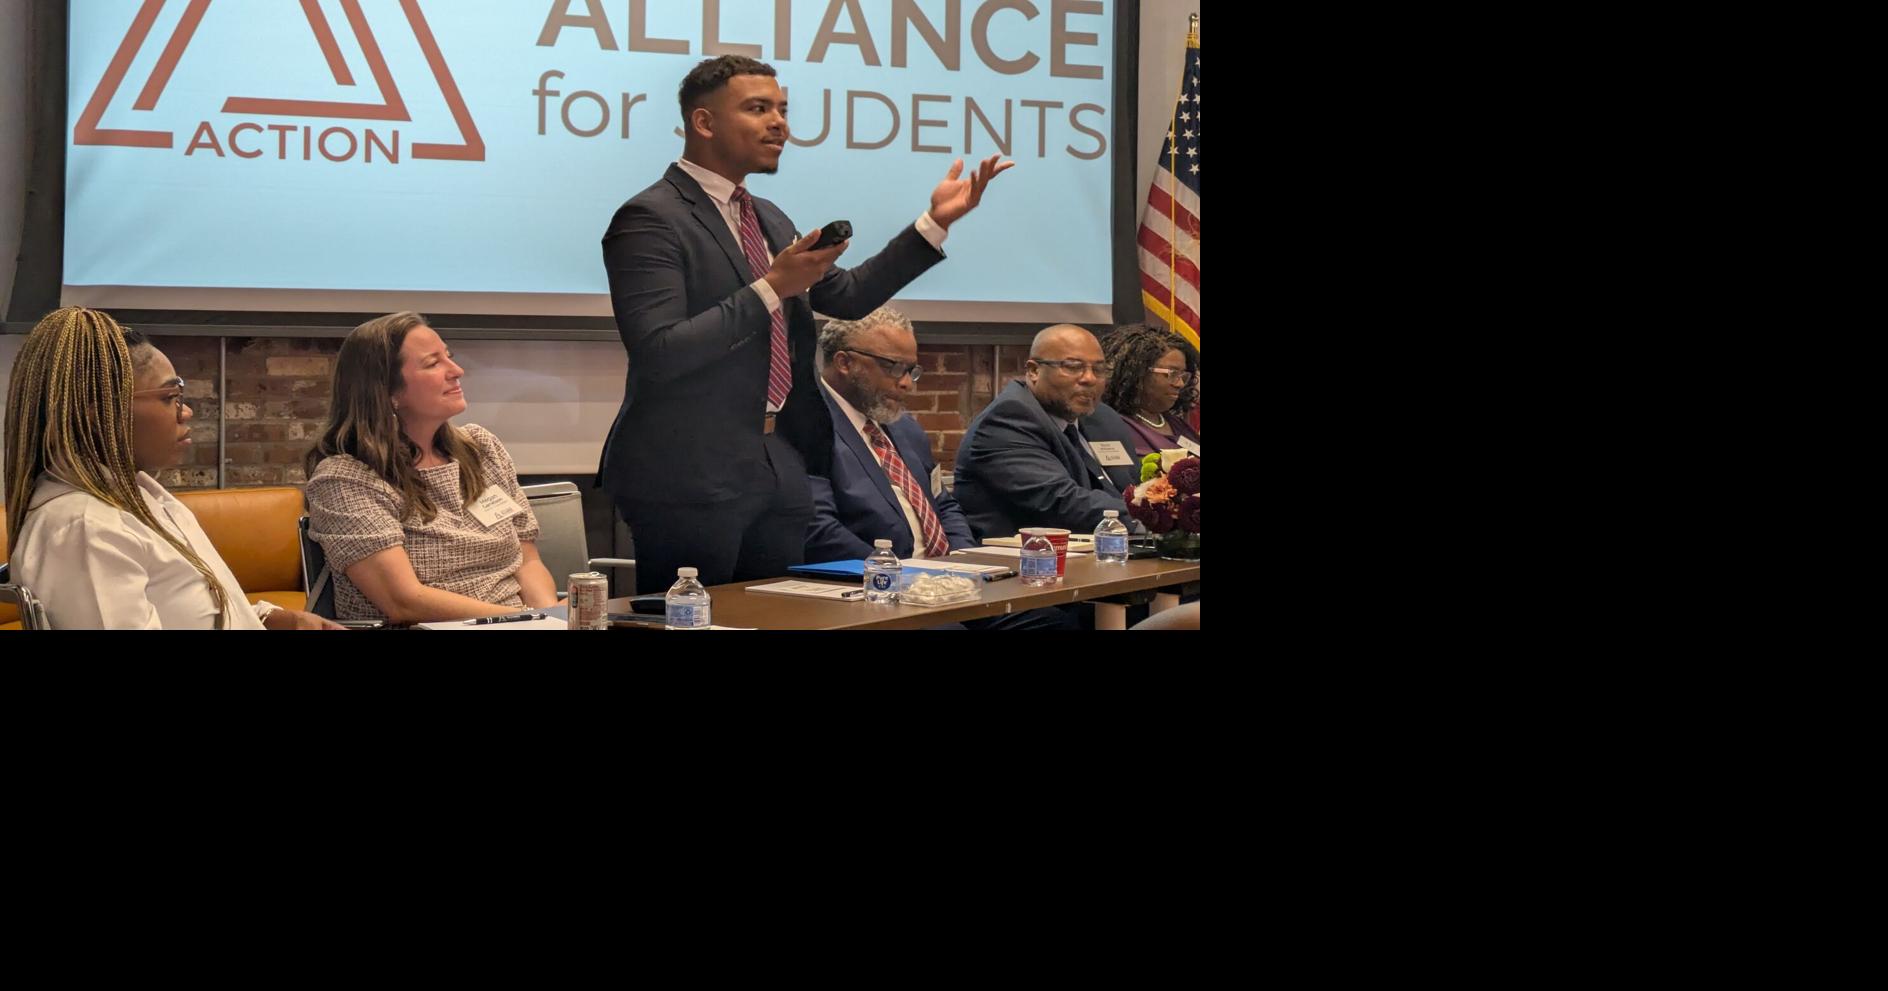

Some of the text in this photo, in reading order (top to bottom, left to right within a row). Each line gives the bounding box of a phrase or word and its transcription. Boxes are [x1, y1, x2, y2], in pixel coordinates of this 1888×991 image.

[536, 0, 1104, 80] ALLIANCE
[184, 121, 399, 164] ACTION
[532, 70, 1107, 161] for UDENTS
